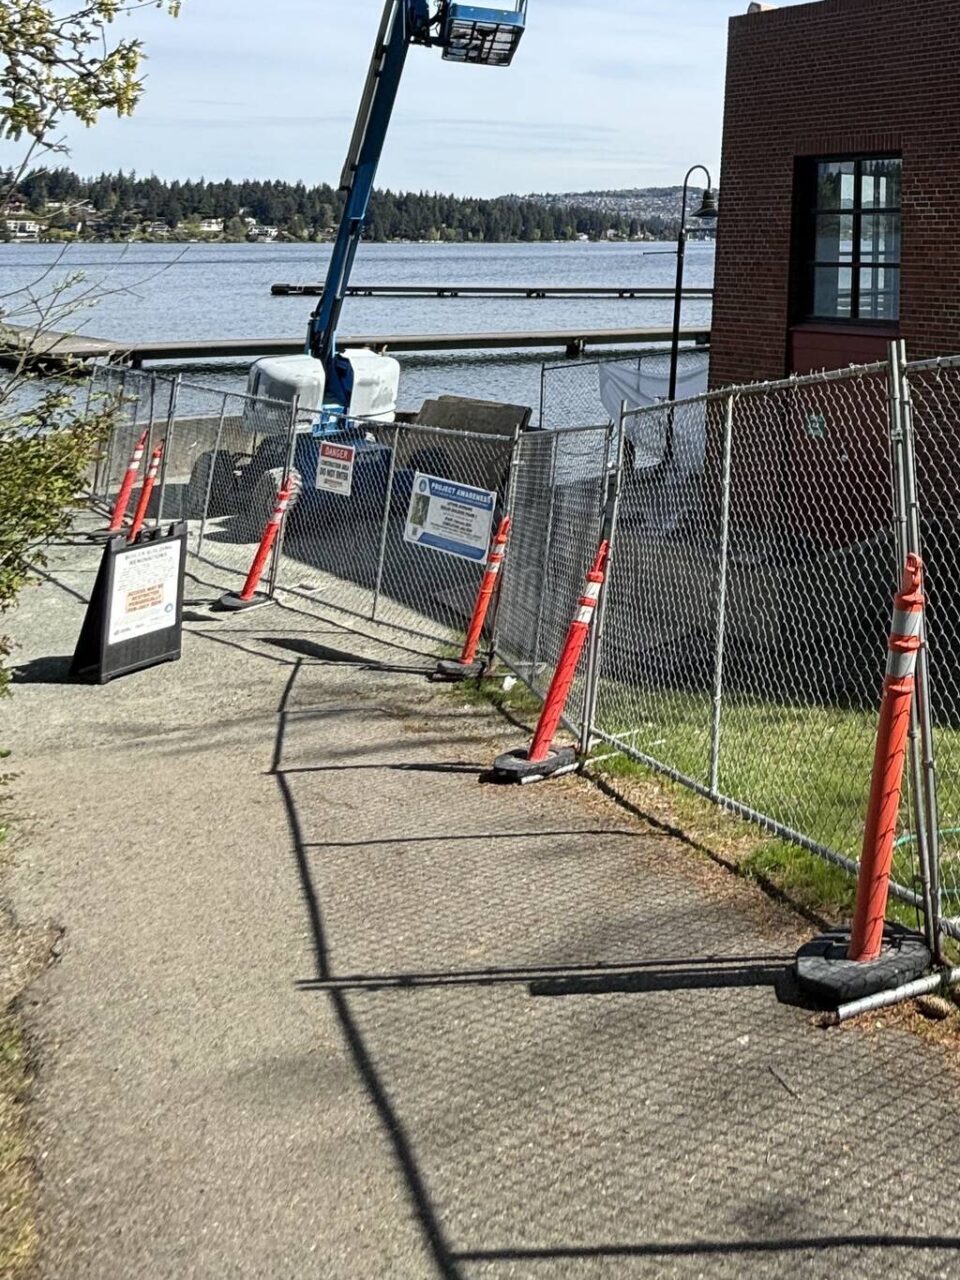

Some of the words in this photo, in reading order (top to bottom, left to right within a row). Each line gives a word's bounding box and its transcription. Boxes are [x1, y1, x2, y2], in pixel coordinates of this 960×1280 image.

[325, 446, 348, 459] DANGER
[431, 482, 455, 494] PROJECT
[457, 488, 491, 503] AWARENESS
